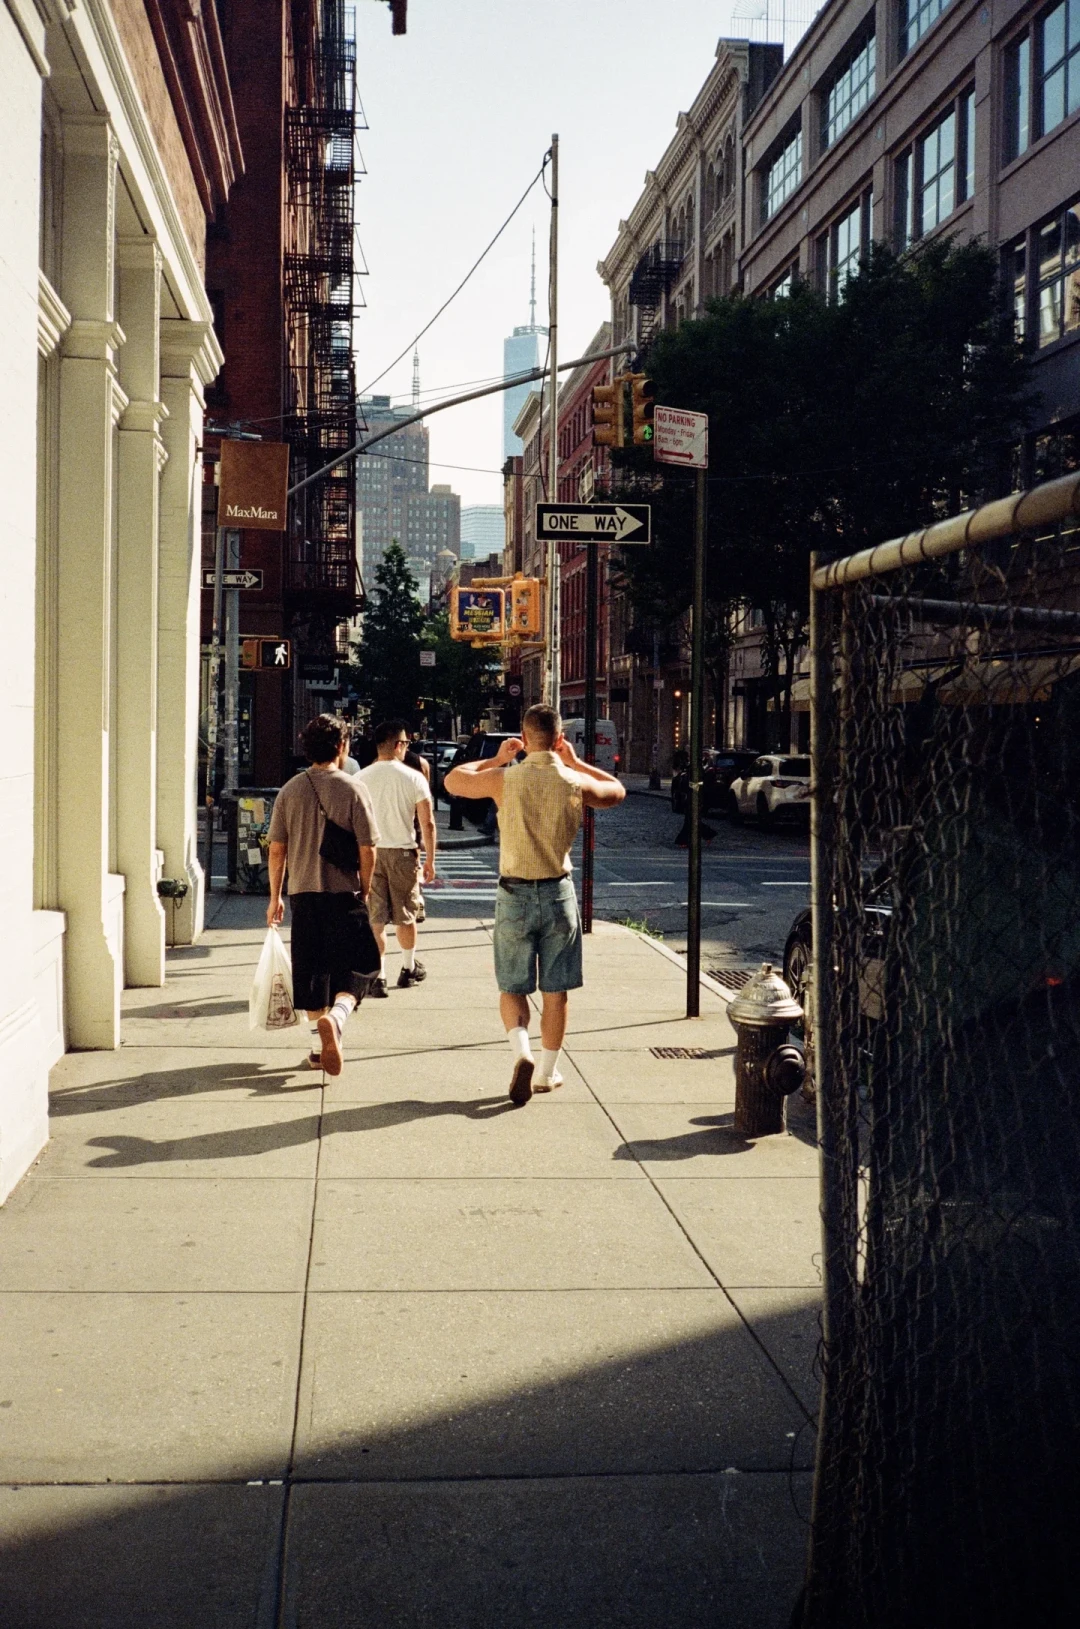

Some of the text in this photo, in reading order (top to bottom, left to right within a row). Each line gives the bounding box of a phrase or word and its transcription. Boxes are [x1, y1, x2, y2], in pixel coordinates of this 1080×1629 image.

[657, 413, 696, 428] NO PARKING
[657, 425, 676, 436] Monday
[680, 428, 696, 439] Friday
[226, 504, 278, 520] MaxMara
[548, 515, 628, 531] ONE WAY
[211, 575, 254, 584] OE WAY
[575, 732, 612, 746] FEx
